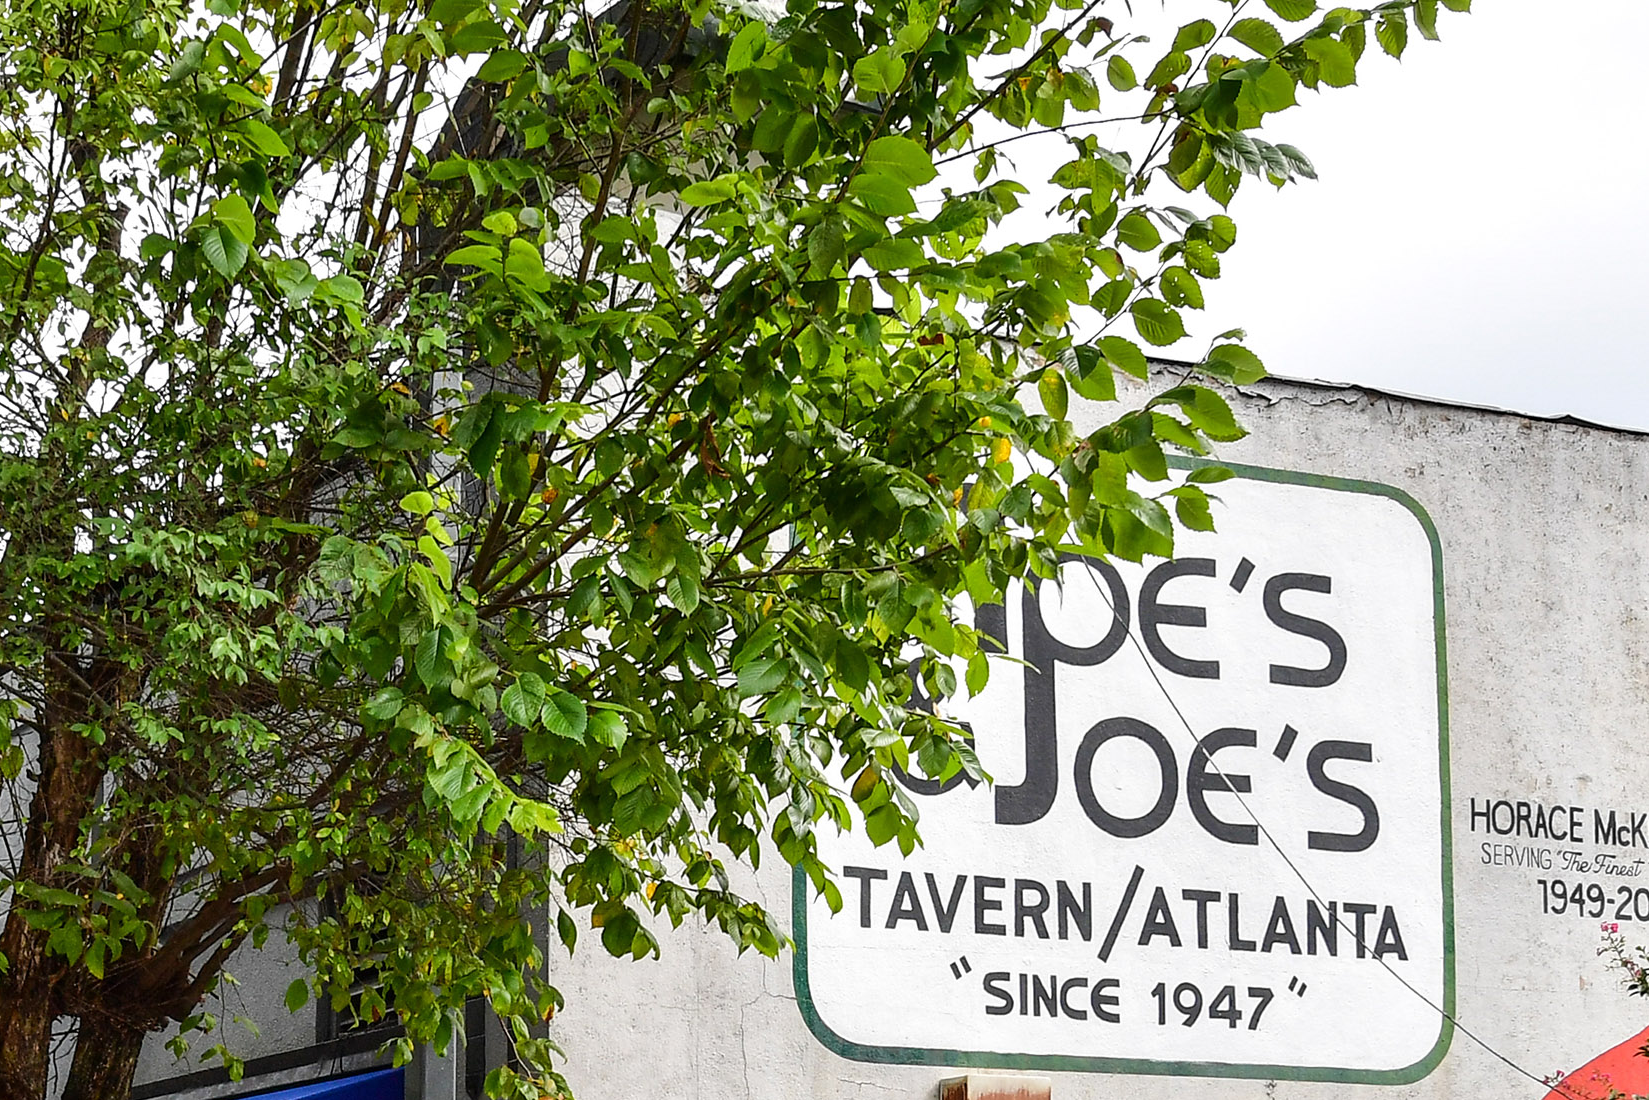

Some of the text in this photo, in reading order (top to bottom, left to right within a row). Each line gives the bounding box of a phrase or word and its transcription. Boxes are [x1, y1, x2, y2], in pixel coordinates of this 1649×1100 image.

[1470, 797, 1584, 843] HORACE
[1481, 842, 1552, 870] SERVING
[1593, 853, 1645, 877] Finest
[843, 864, 1409, 962] TAVERN/ATLANTA
[1537, 879, 1649, 922] 1949-20
